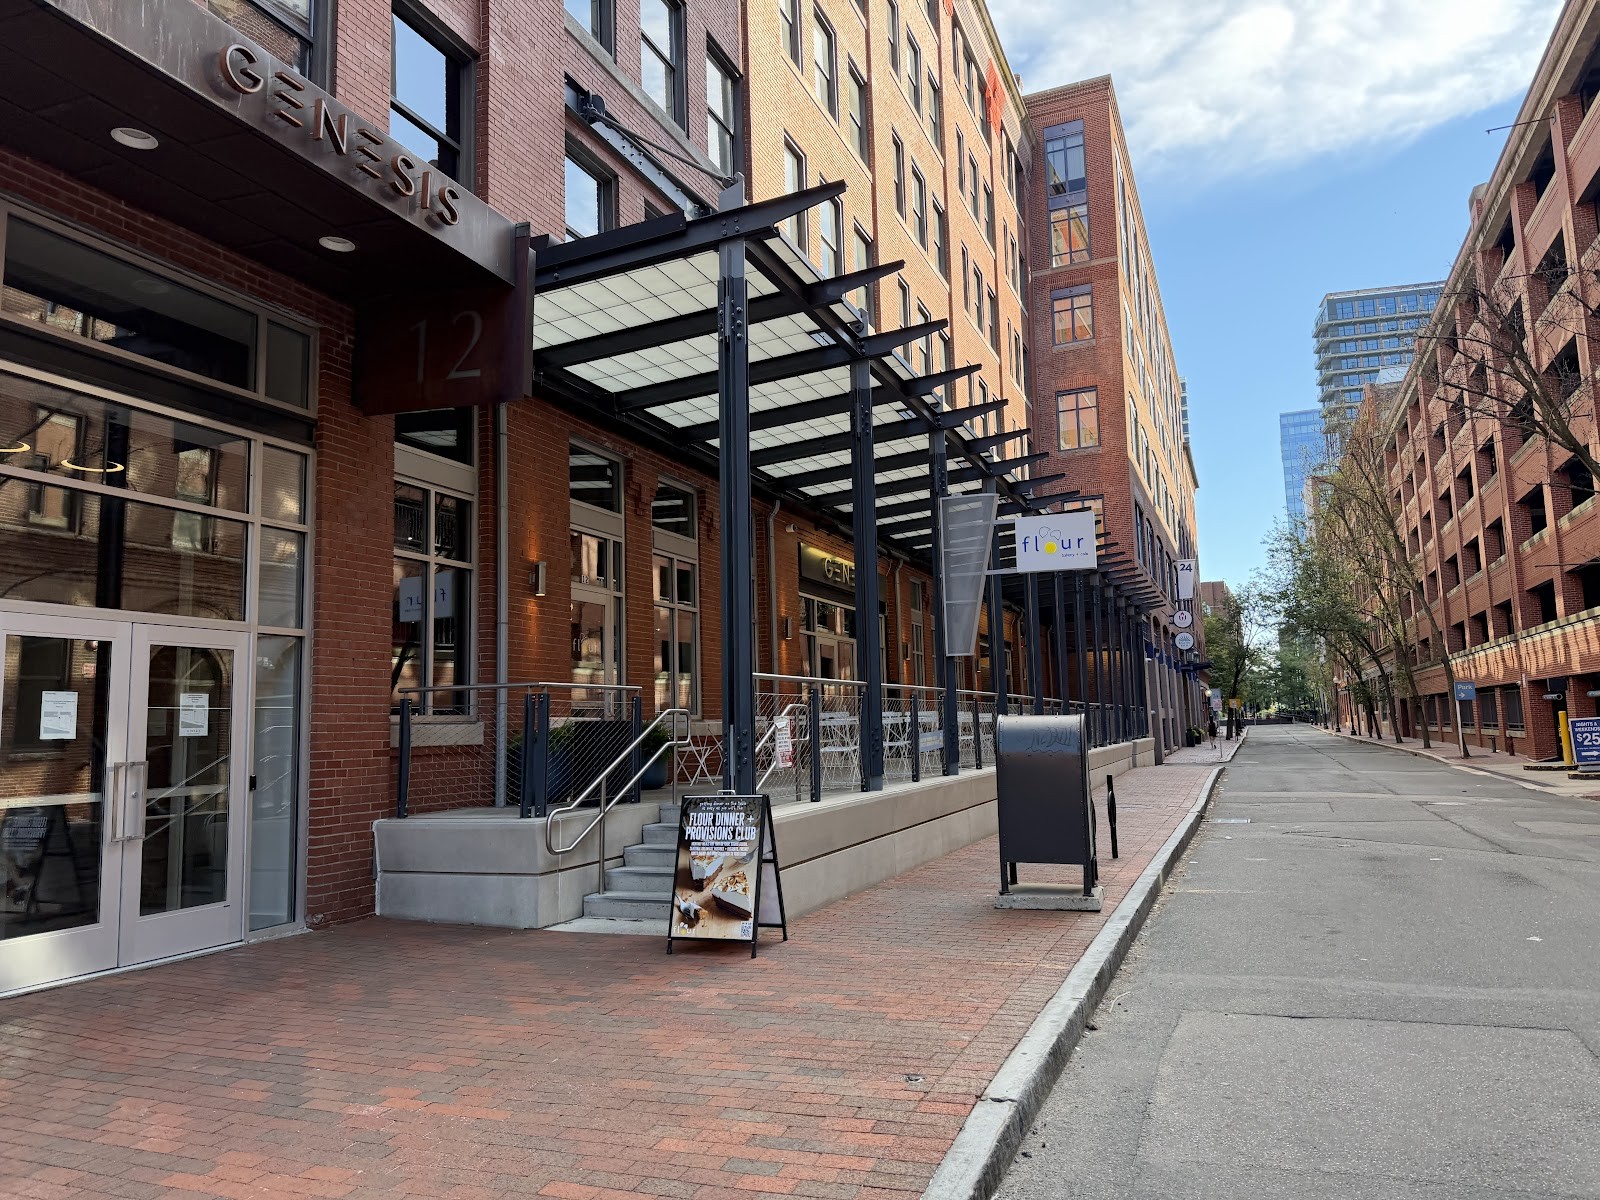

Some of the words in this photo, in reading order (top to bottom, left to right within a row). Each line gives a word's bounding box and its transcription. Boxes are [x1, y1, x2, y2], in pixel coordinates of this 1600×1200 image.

[219, 43, 461, 226] GENESIS
[408, 310, 482, 385] 12
[1022, 536, 1084, 555] flour
[1179, 563, 1193, 573] 24
[689, 812, 713, 826] FLOUR
[715, 812, 745, 826] DINNER
[685, 826, 734, 841] PROVISIONS
[735, 826, 757, 841] CLUB
[673, 925, 696, 935] flour
